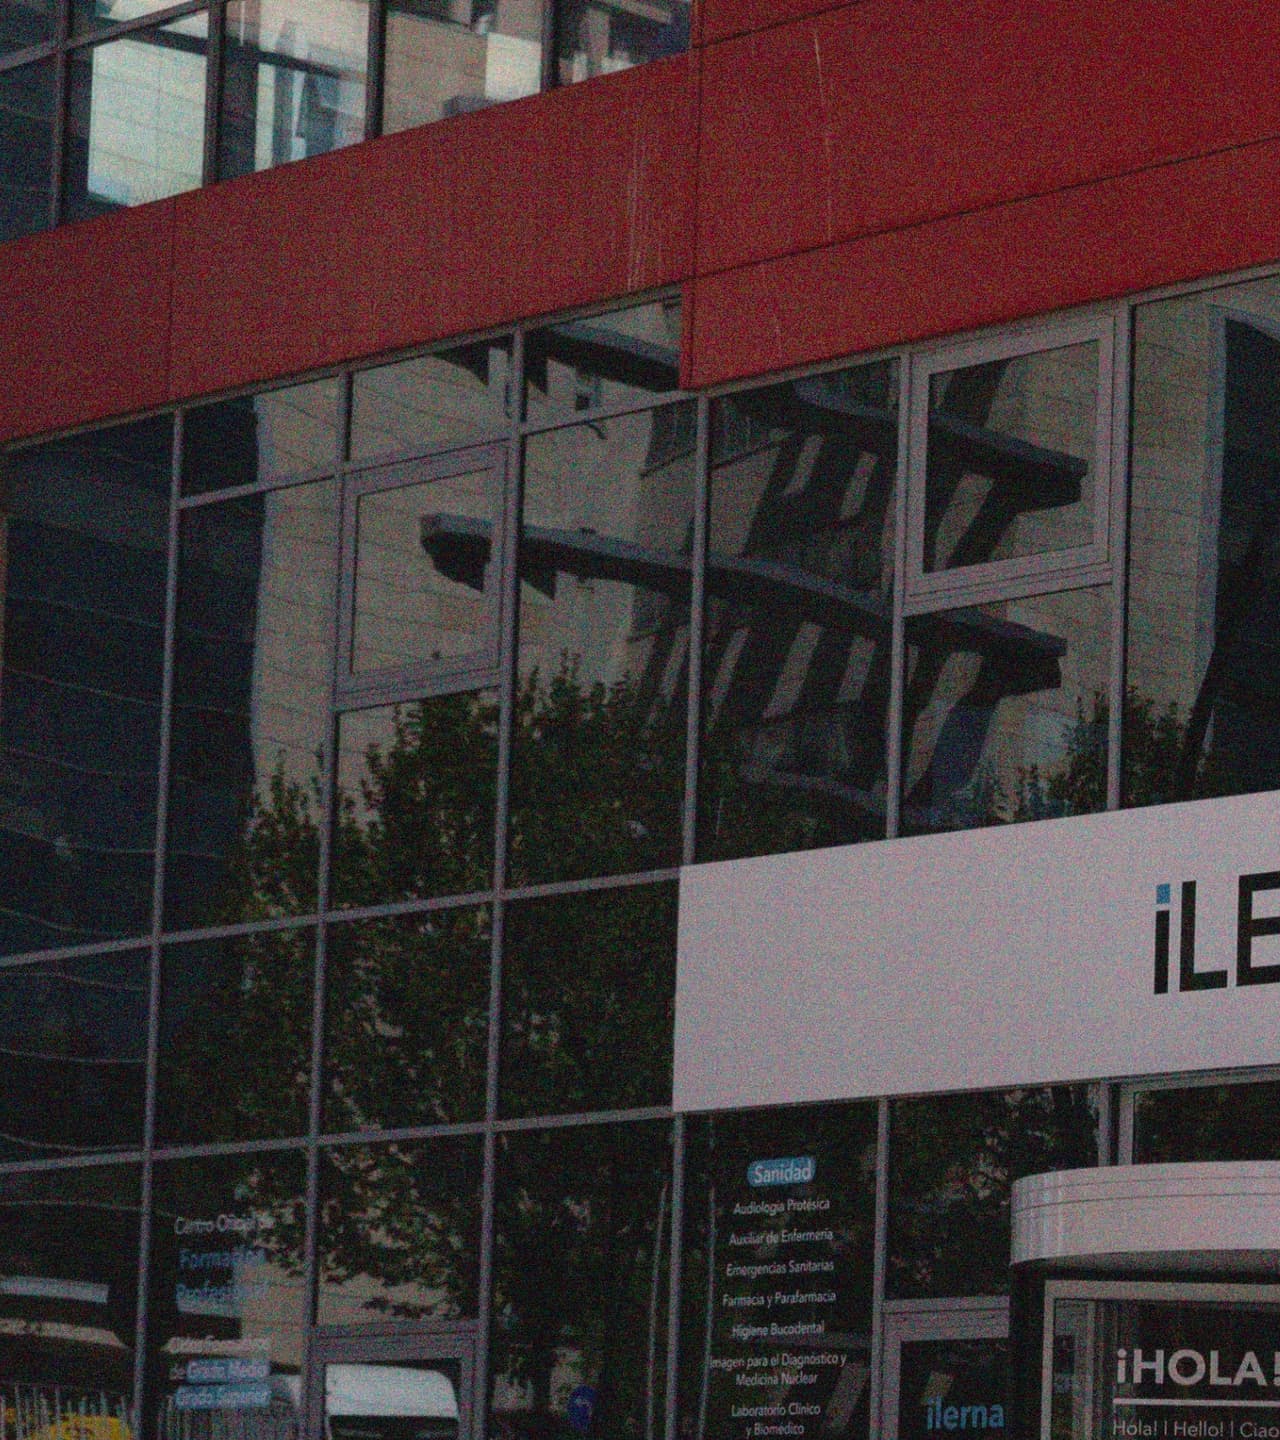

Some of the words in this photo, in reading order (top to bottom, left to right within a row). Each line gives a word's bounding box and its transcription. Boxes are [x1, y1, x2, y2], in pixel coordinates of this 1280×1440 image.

[754, 1159, 812, 1183] Sanidad
[1112, 1420, 1157, 1436] Hola!
[1174, 1421, 1224, 1437] Hello!
